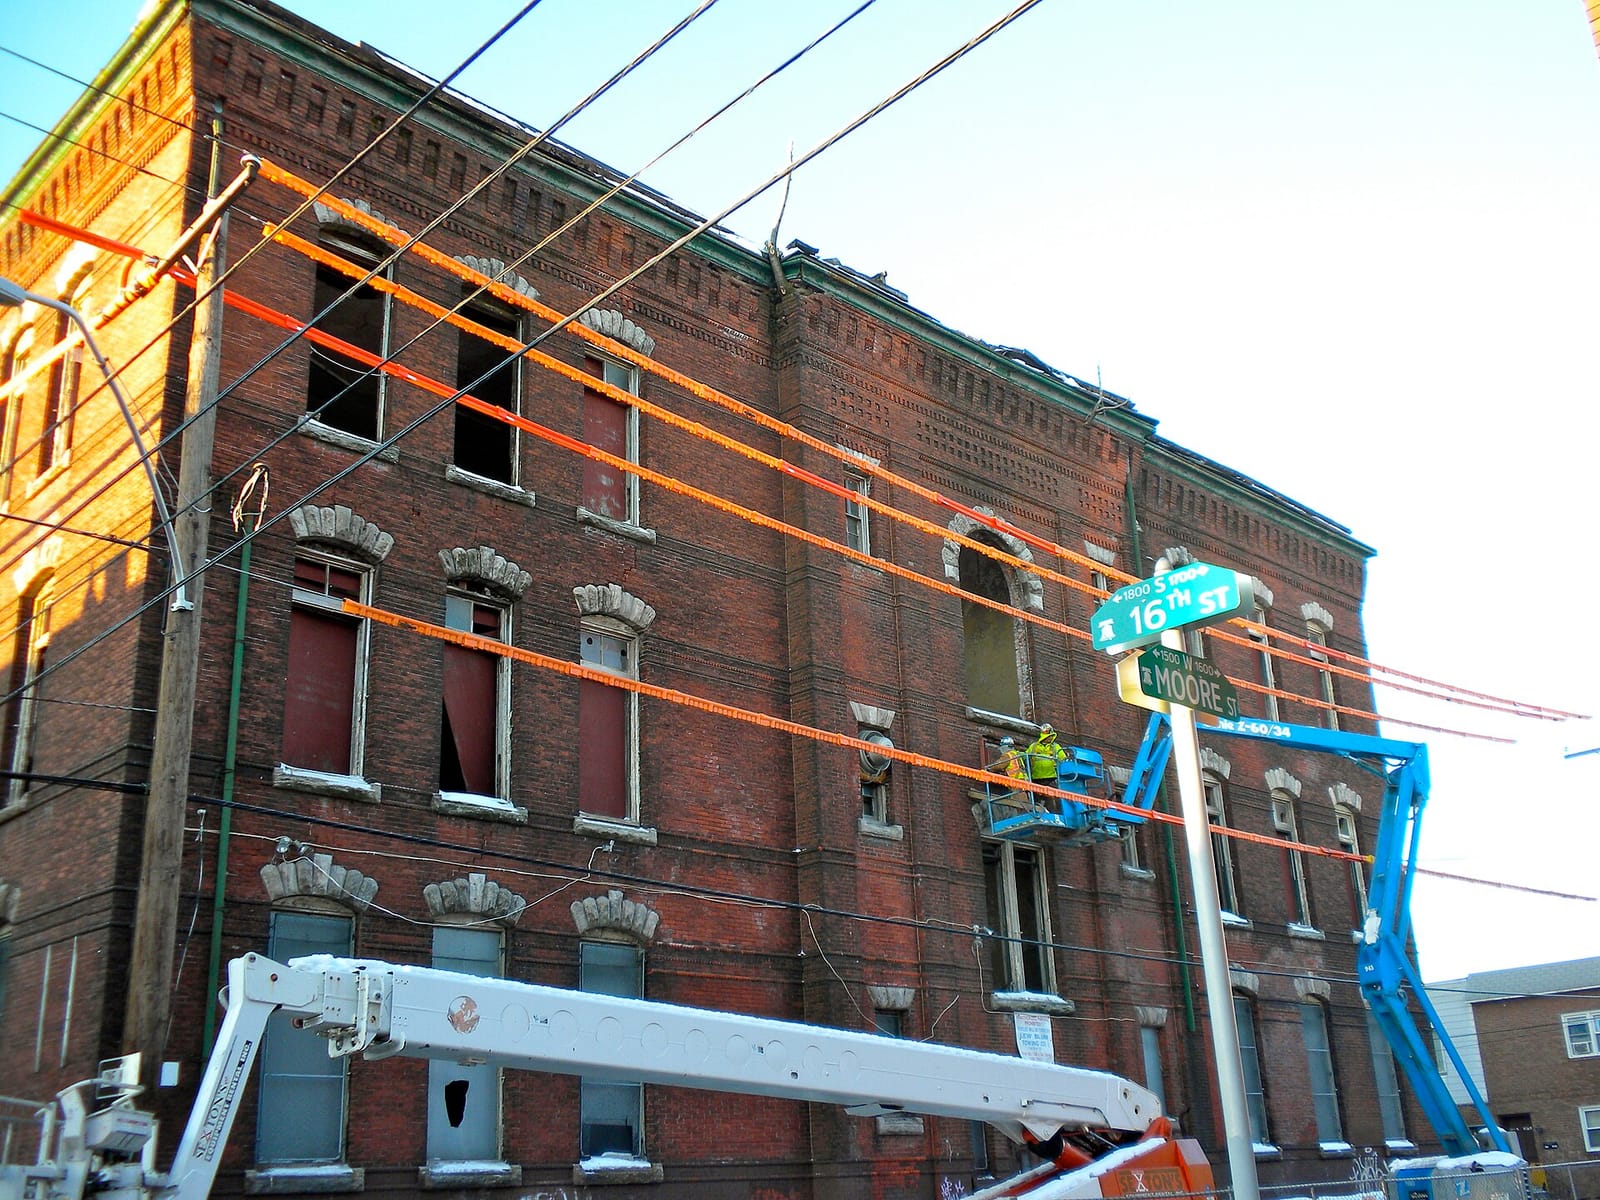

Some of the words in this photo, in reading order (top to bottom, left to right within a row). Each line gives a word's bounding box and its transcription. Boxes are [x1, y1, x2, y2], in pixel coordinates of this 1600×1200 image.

[1123, 583, 1151, 601] 1800
[1154, 576, 1167, 594] S
[1129, 588, 1192, 635] 16TH
[1198, 585, 1230, 615] ST
[1160, 649, 1181, 665] 1500
[1182, 653, 1193, 671] W
[1154, 664, 1224, 713] MOORE
[1227, 696, 1237, 717] ST
[1238, 721, 1291, 738] Z-60/34
